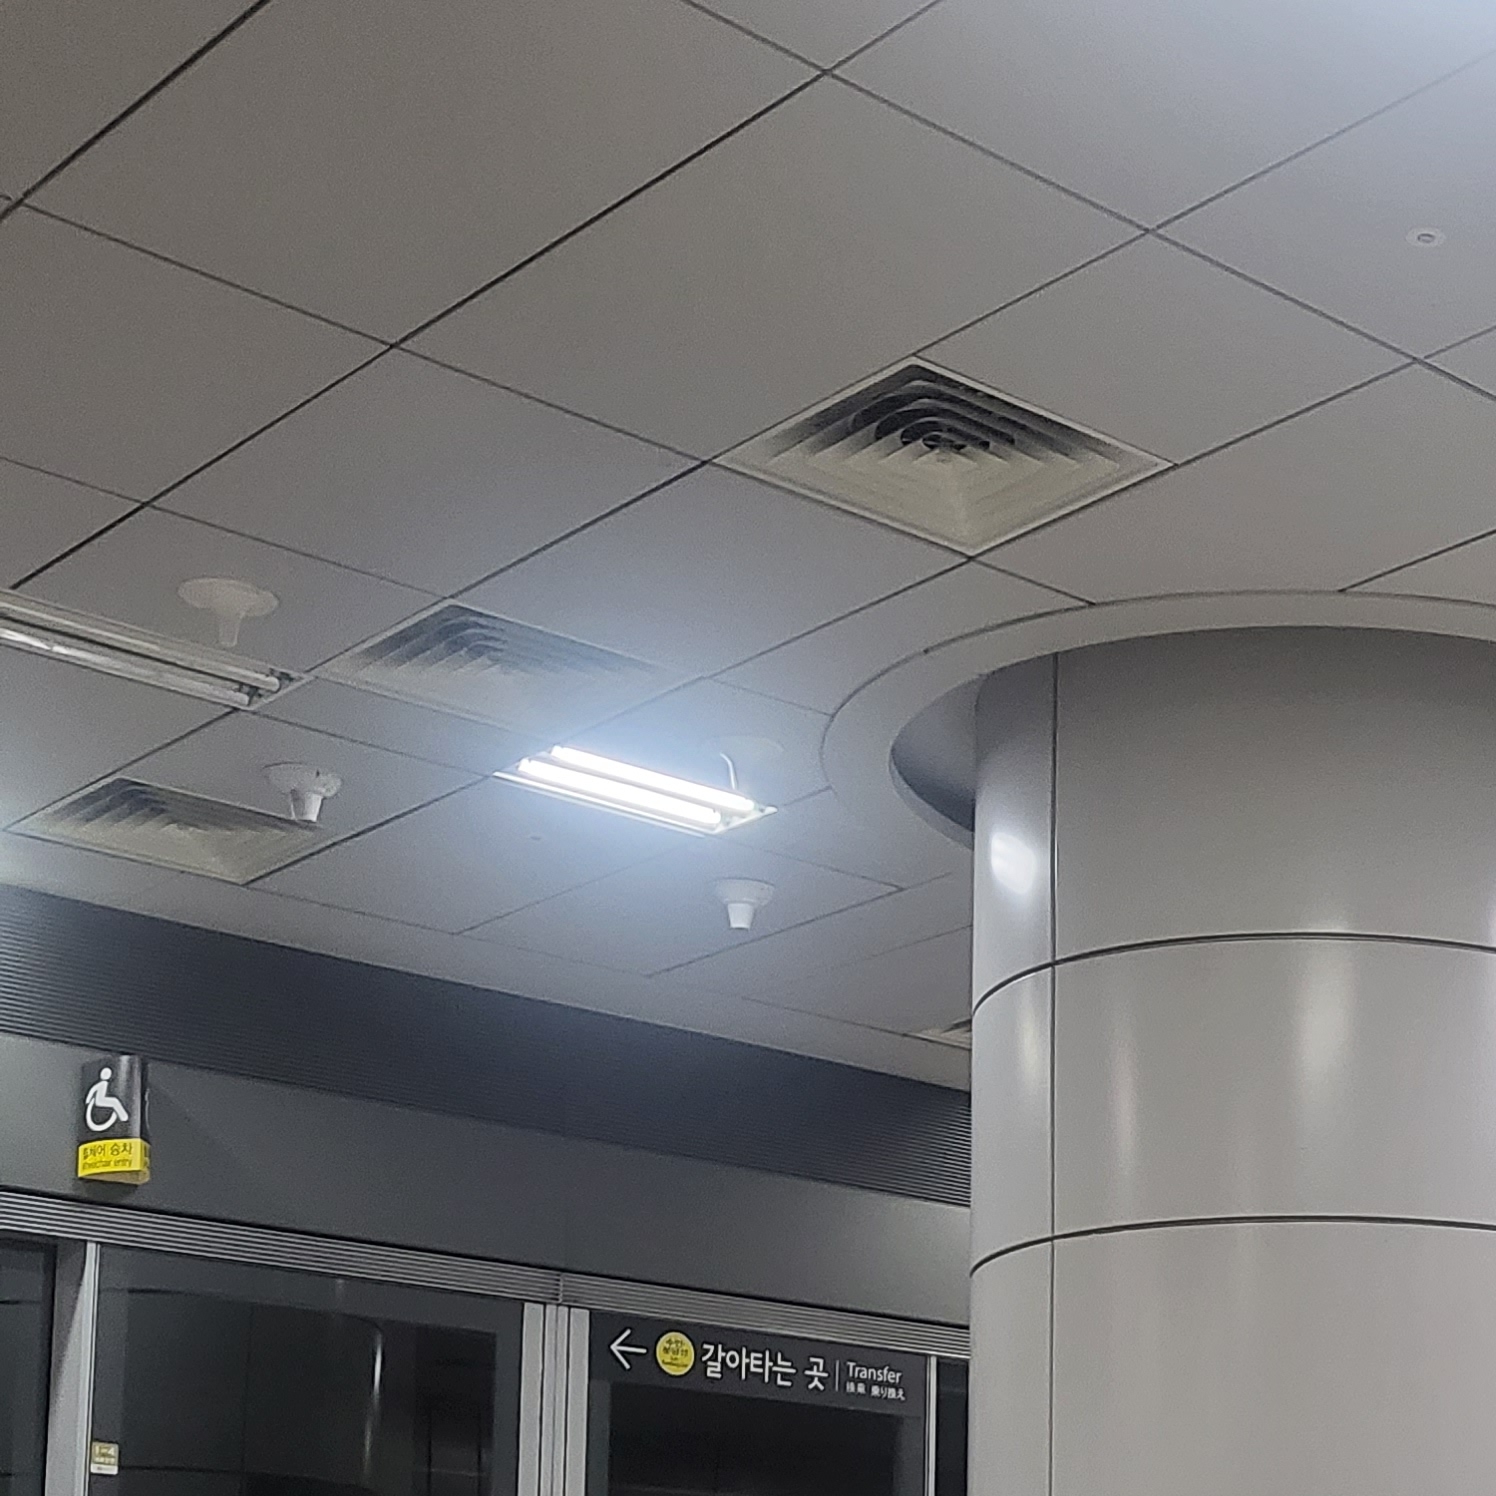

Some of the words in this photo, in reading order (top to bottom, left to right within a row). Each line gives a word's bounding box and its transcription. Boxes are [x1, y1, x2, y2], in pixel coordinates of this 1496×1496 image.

[110, 1143, 132, 1156] 승차
[702, 1344, 796, 1387] 갈아타는
[804, 1357, 829, 1391] 곳
[847, 1361, 902, 1384] Transfer
